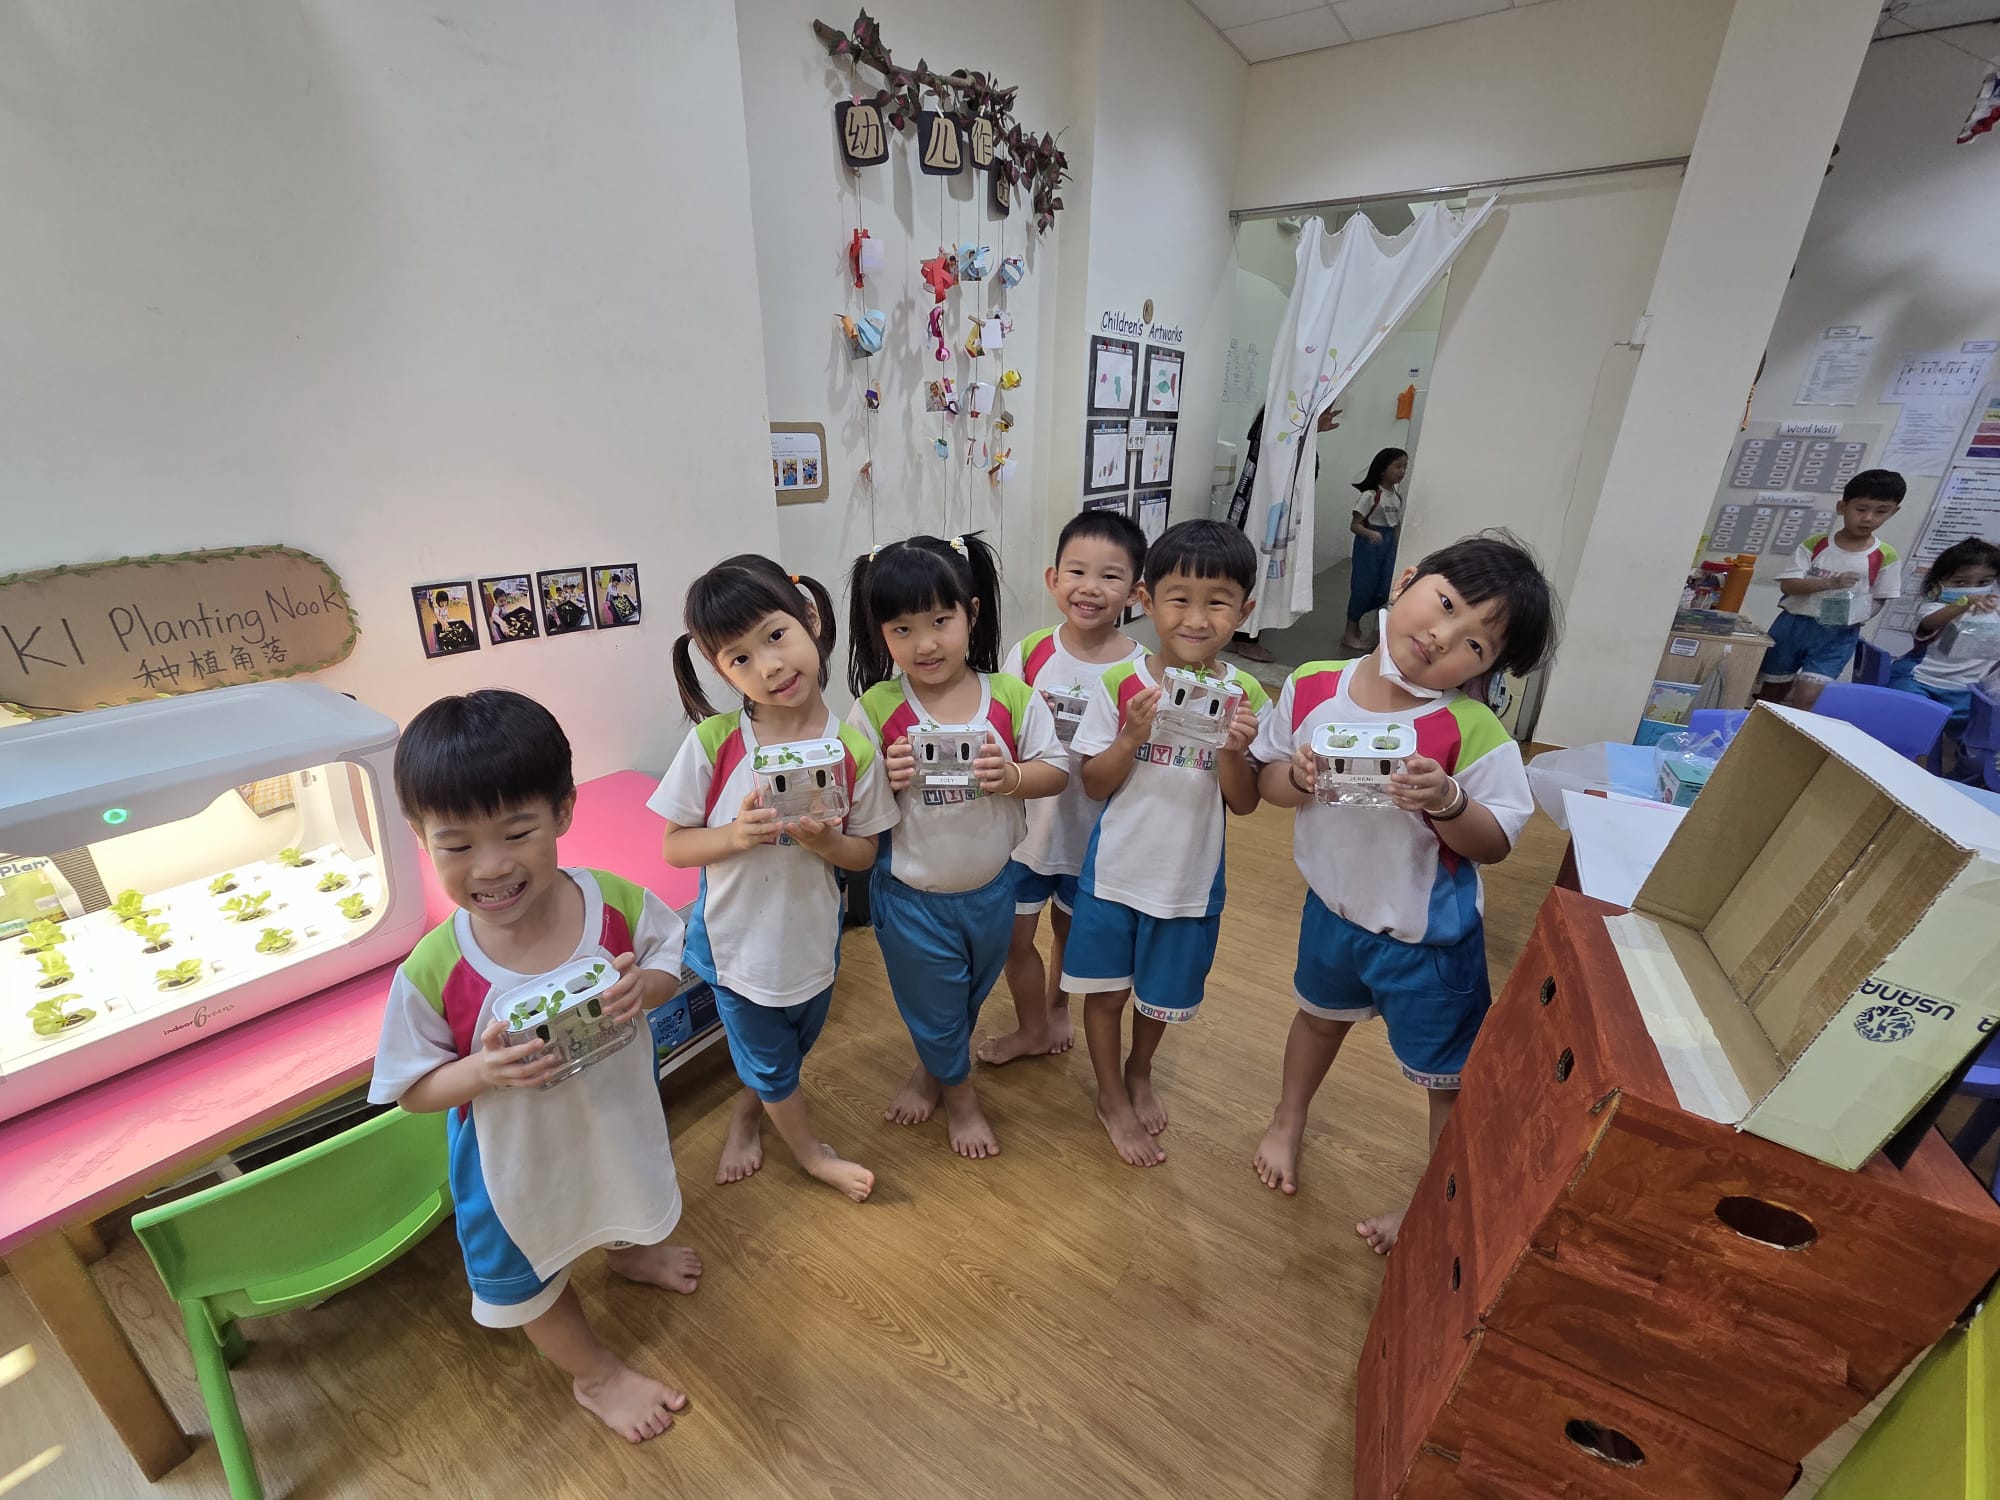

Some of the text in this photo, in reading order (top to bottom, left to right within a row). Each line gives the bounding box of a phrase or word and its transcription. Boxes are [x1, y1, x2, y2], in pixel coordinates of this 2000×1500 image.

[1102, 311, 1144, 336] Children's
[1148, 323, 1183, 342] Artworks
[1787, 423, 1837, 434] Word Wall
[108, 602, 265, 653] Planting
[265, 584, 344, 624] Nook
[132, 636, 289, 690] 种植角落
[1860, 979, 1955, 1021] USANA
